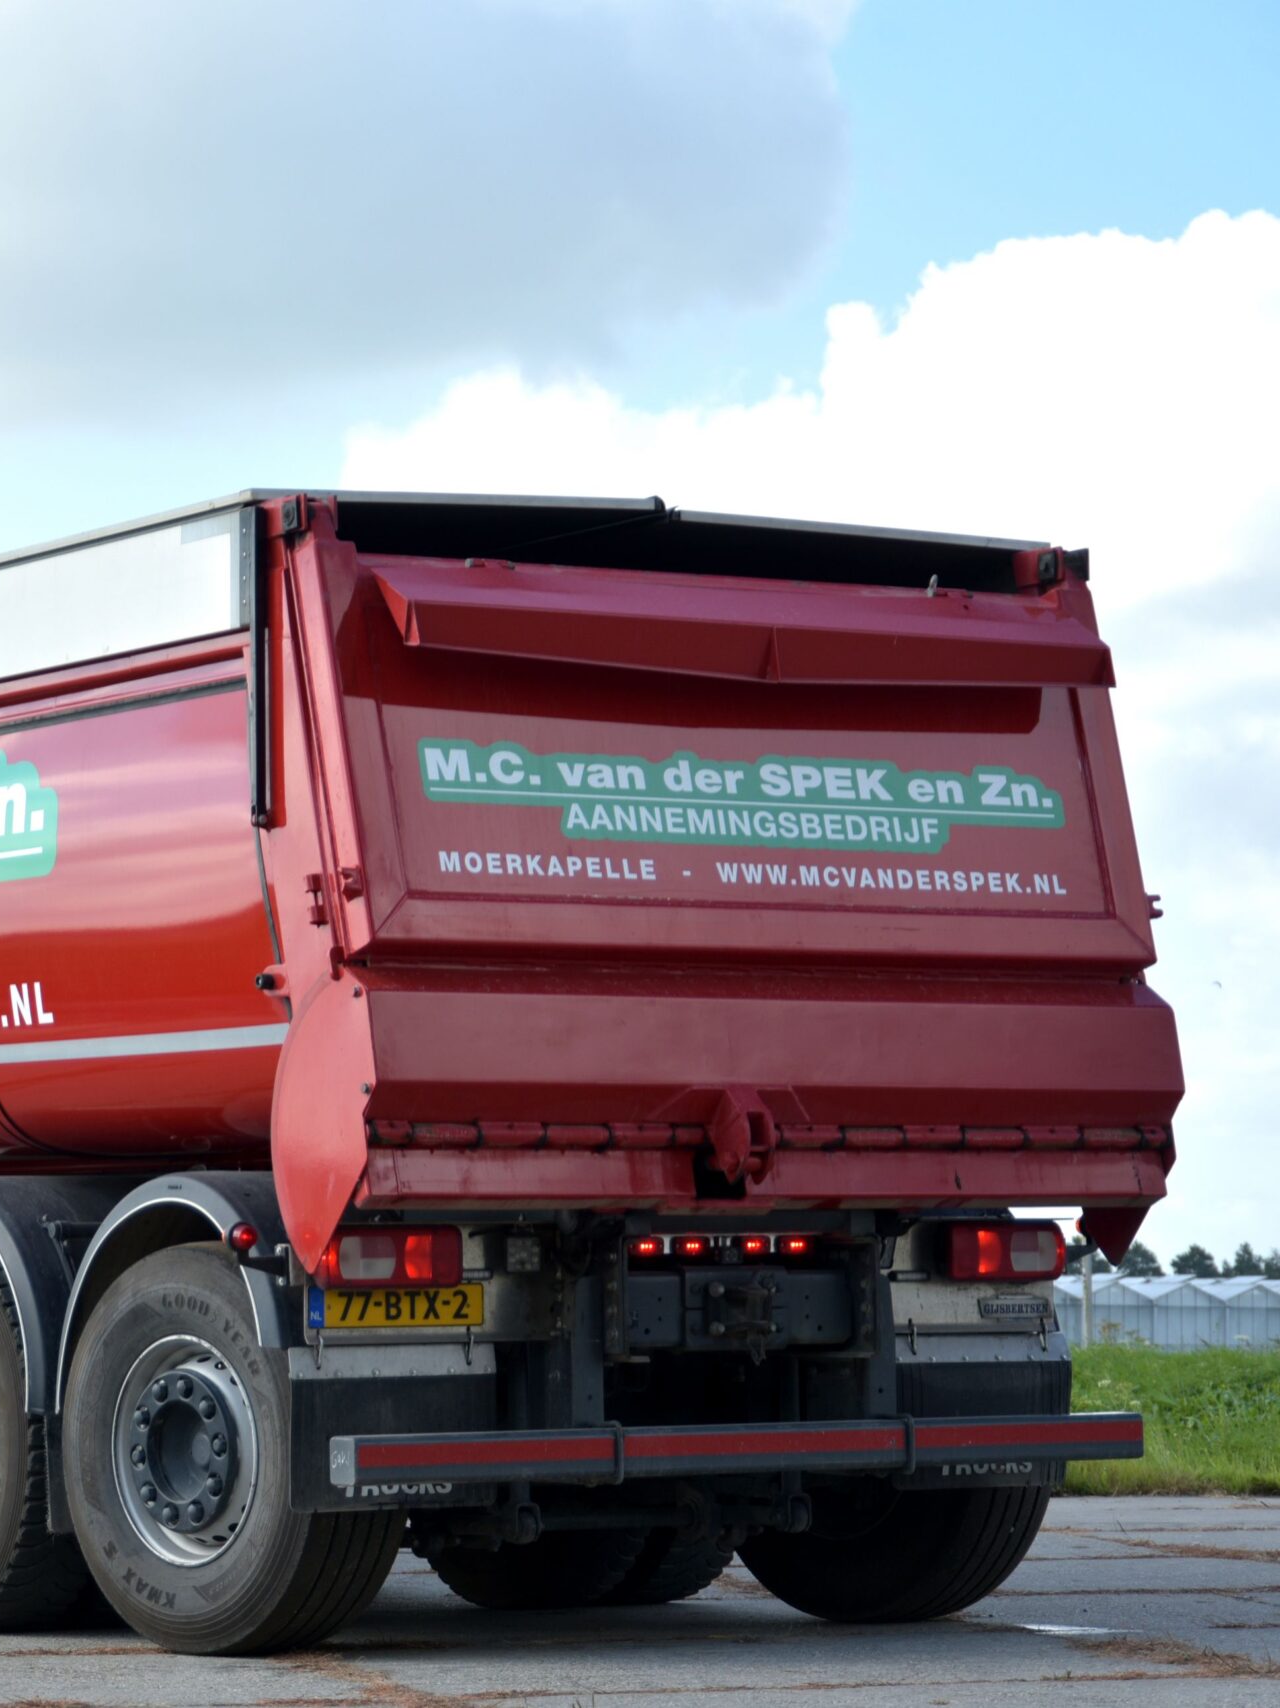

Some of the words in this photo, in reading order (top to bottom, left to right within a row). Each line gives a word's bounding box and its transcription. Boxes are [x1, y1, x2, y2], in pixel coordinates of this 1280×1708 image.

[424, 747, 541, 786] M.C.
[557, 762, 646, 790] van
[663, 760, 744, 794] der
[760, 763, 893, 802] SPEK
[908, 777, 965, 805] en
[980, 774, 1053, 808] Zn.
[567, 803, 938, 844] AANNEMINGSBEDRIJF
[439, 851, 657, 881] MOERKAPELLE
[716, 862, 1067, 896] WWW.MCVANDERSPEK.NL
[310, 1311, 322, 1322] NL
[337, 1290, 470, 1322] 77-BTX-2
